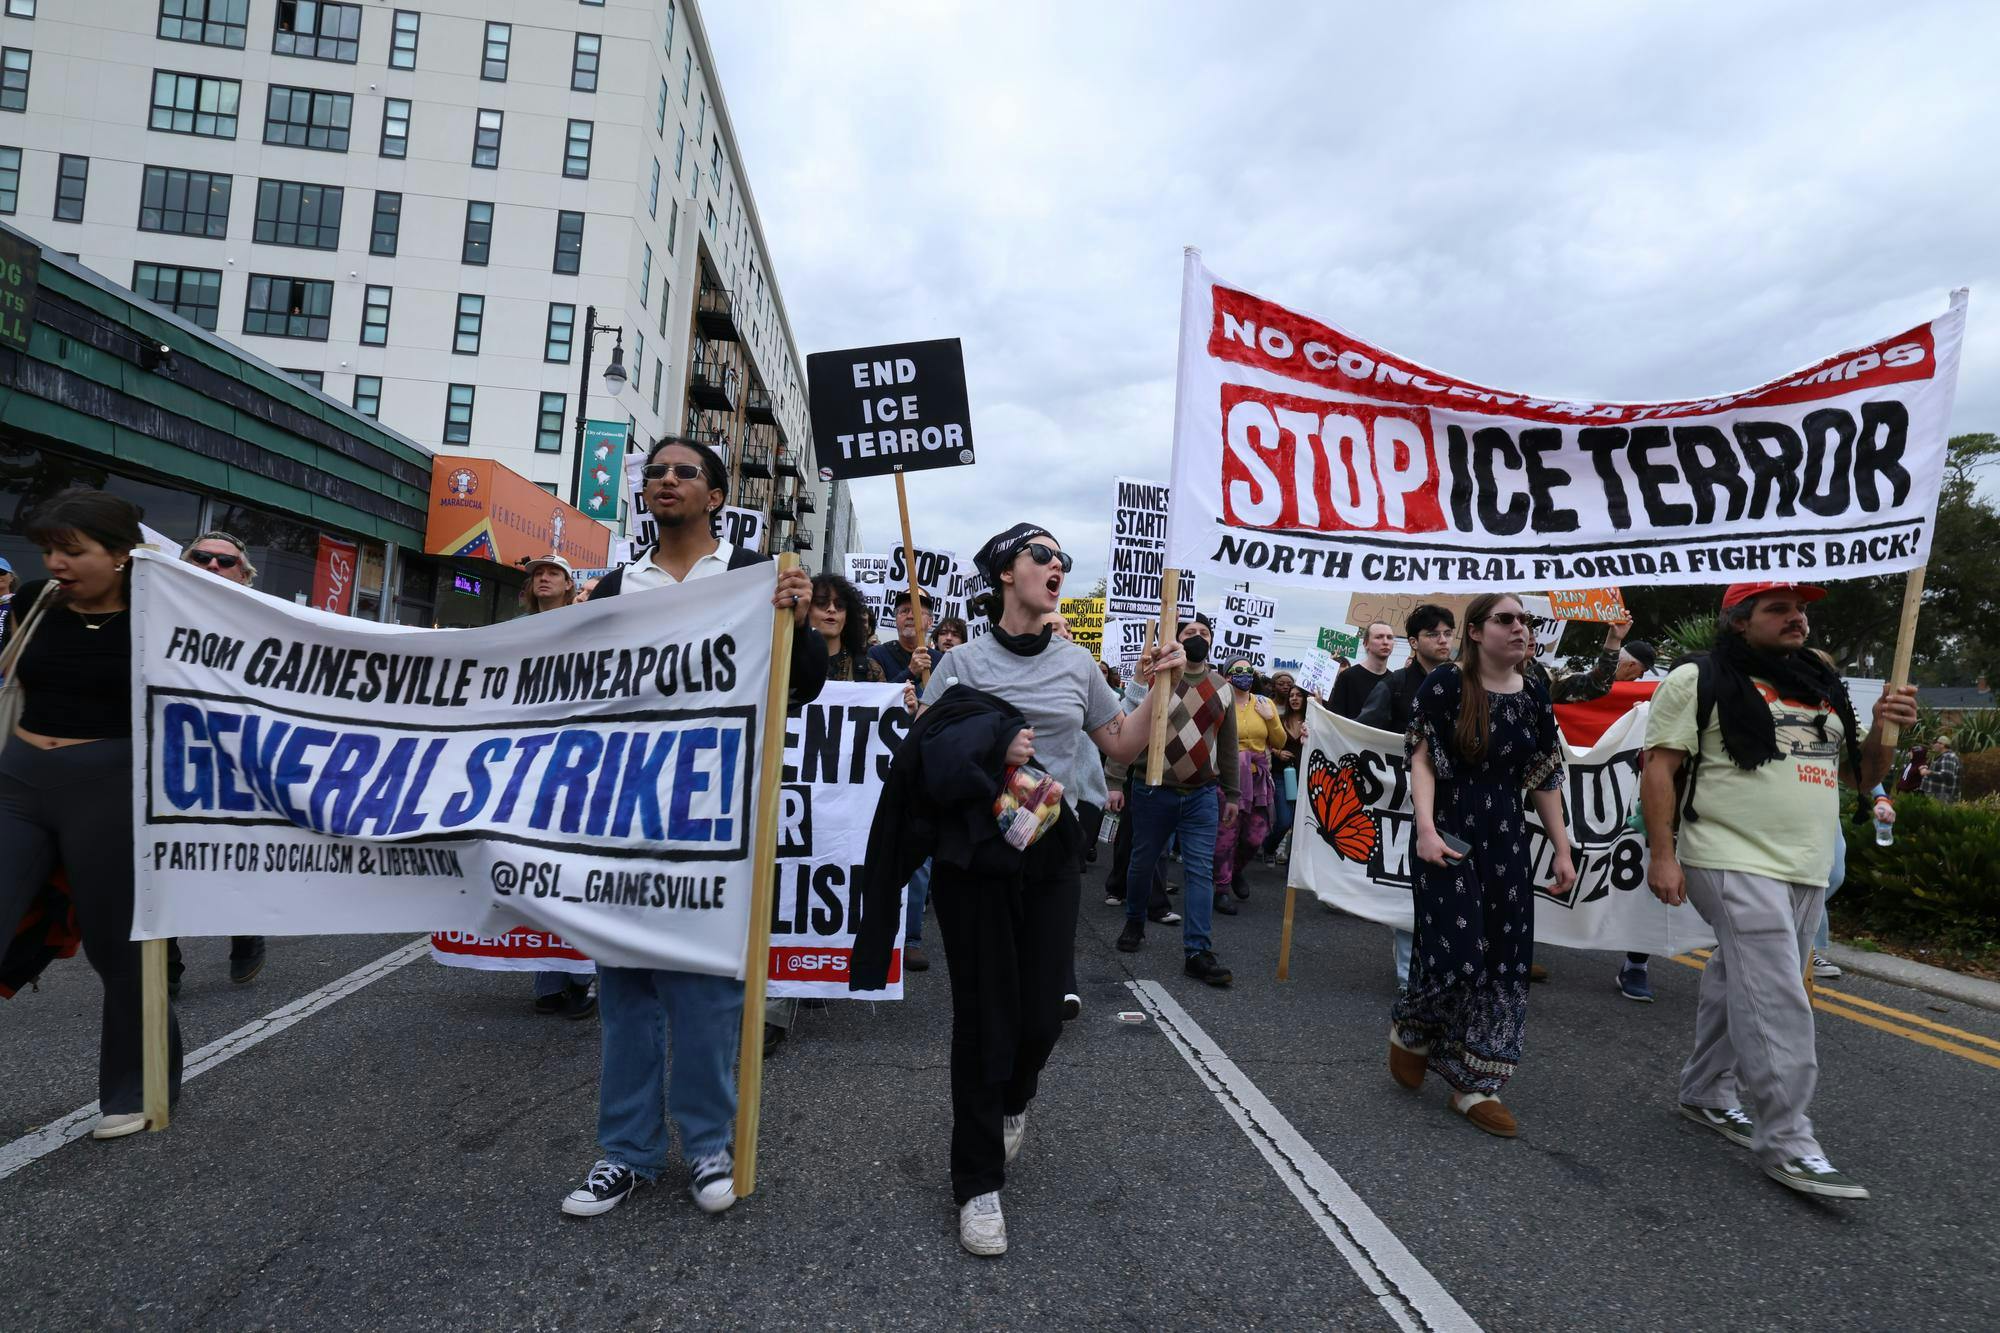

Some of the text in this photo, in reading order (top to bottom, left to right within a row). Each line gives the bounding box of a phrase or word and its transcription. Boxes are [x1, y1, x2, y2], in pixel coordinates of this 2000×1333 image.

[0, 289, 24, 312] TS
[1222, 310, 1294, 359] NO
[852, 358, 916, 388] END
[862, 395, 919, 424] ICE
[837, 423, 964, 459] TERROR
[1227, 400, 1912, 536] STOP ICE TERROR
[440, 497, 483, 510] MARACUCHA
[492, 503, 548, 541] VENEZUELAN
[1115, 536, 1152, 548] TIME
[852, 558, 872, 569] SHUT
[1211, 527, 1922, 582] NORTH CENTRAL FLORIDA FIGHTS BACK!
[1112, 572, 1195, 602] SHUTDN!
[1553, 591, 1586, 603] DENY
[1060, 602, 1104, 614] GAINESVILLE
[1111, 601, 1126, 610] PARTY
[1127, 602, 1137, 611] FOR
[1225, 595, 1274, 618] ICE OUT
[1554, 605, 1593, 619] HUMAN
[1233, 615, 1260, 627] OF
[1120, 644, 1141, 652] ICE
[1224, 630, 1263, 650] UF
[1322, 638, 1356, 656] TRUMP
[165, 626, 737, 706] FROM GAINESVILLE TO MINNEAPOLIS
[1213, 645, 1265, 667] CAMPUS
[1274, 657, 1299, 669] Bank
[163, 702, 742, 842] GENERAL STRIKE!
[1797, 764, 1828, 777] LOOK
[1799, 773, 1822, 784] HIM
[154, 841, 464, 878] PARTY FOR SOCIALISM & LIBERATION
[491, 860, 727, 909] @PSL_GAINESVILLE
[787, 954, 851, 972] @SFS
